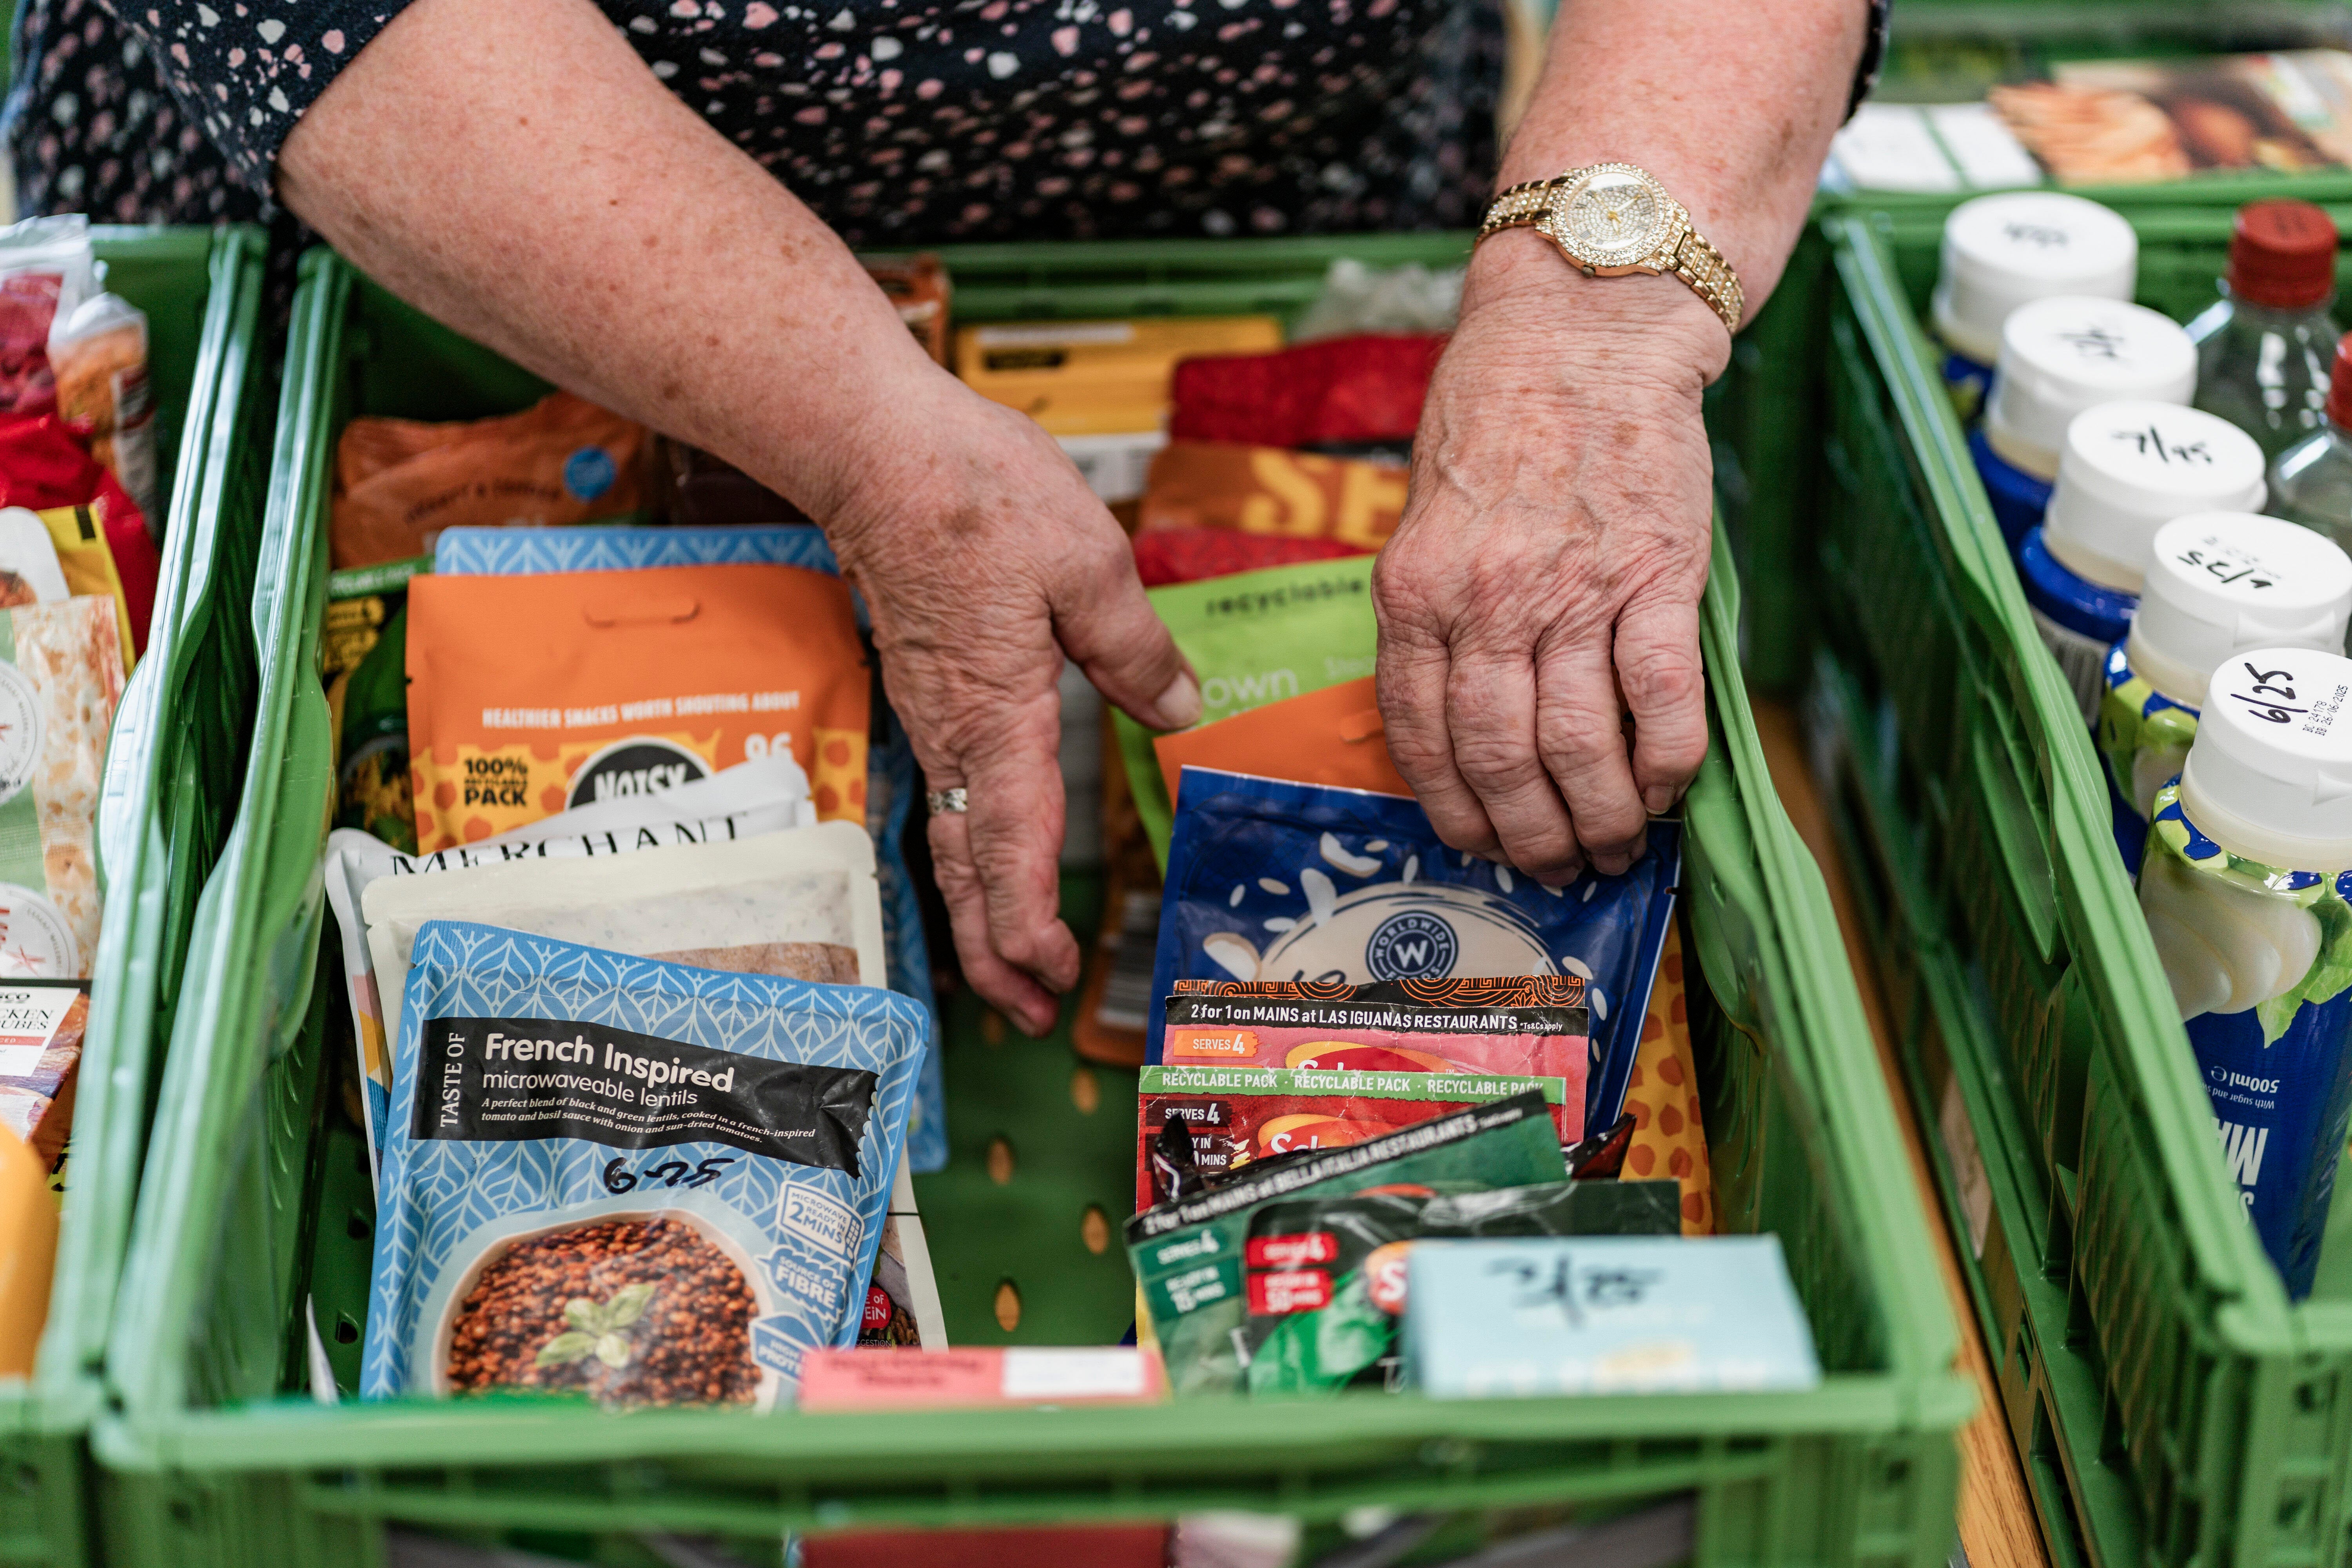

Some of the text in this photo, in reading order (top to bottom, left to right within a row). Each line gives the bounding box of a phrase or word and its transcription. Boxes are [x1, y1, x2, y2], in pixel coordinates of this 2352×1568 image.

[2230, 662, 2308, 723] 6/25
[482, 691, 799, 729] HEALTHIER SNACKS WORTH SHOUTING ABOUT
[465, 757, 528, 776] 100%
[465, 787, 527, 807] PACK
[1375, 918, 1449, 958] WORLDWIDE
[1394, 940, 1428, 969] W
[1191, 1004, 1198, 1018] 2
[1201, 1004, 1223, 1019] for
[1225, 1005, 1231, 1019] 1
[1233, 1007, 1250, 1020] on
[1254, 1006, 1299, 1022] MAINS
[1302, 1009, 1316, 1022] at
[1319, 1010, 1347, 1024] LAS
[1350, 1010, 1411, 1027] IGUANAS
[1414, 1014, 1517, 1030] RESTAURANTS
[1545, 1022, 1563, 1032] apply
[1193, 1034, 1245, 1054] SERVES 4
[485, 1033, 735, 1093] French Inspired
[440, 1032, 465, 1127] TASTE OF
[483, 1070, 698, 1107] microwaveable lentils
[1162, 1073, 1241, 1087] RECYCLABLE
[1245, 1074, 1278, 1088] PACK
[1294, 1074, 1373, 1091] RECYCLABLE
[1377, 1077, 1410, 1092] PACK
[1428, 1079, 1507, 1096] RECYCLABLE
[2212, 1087, 2228, 1098] and
[2229, 1072, 2280, 1093] 500ml
[2230, 1093, 2253, 1105] sugar
[2255, 1099, 2274, 1109] With
[481, 1098, 490, 1107] A
[491, 1099, 526, 1110] perfect
[529, 1098, 554, 1107] blend
[556, 1098, 569, 1106] of
[570, 1098, 595, 1111] black
[597, 1105, 615, 1115] and
[617, 1110, 645, 1123] green
[646, 1112, 680, 1123] lentils,
[682, 1111, 717, 1120] cooked
[737, 1122, 815, 1139] french-inspired
[481, 1110, 763, 1143] tomato and basil sauce with onion and sun-dried tomatoes.
[1165, 1103, 1220, 1124] SERVES 4
[1201, 1137, 1210, 1149] IN
[1142, 1217, 1155, 1235] 2
[1156, 1209, 1180, 1231] for
[1189, 1202, 1208, 1219] on
[1207, 1182, 1255, 1214] MAINS
[1256, 1180, 1274, 1199] at
[1273, 1163, 1321, 1193] BELLA
[1320, 1146, 1371, 1183] ITALIA
[1370, 1113, 1478, 1163] RESTAURANTS
[1201, 1155, 1227, 1166] MINS
[792, 1192, 847, 1223] MICROWAVE
[806, 1207, 846, 1232] READY IN
[1156, 1229, 1220, 1265] SERVES 4
[1308, 1234, 1326, 1261] 4
[779, 1256, 837, 1290] SOURCE OF
[775, 1265, 837, 1310] FIBRE
[873, 1294, 884, 1305] OF
